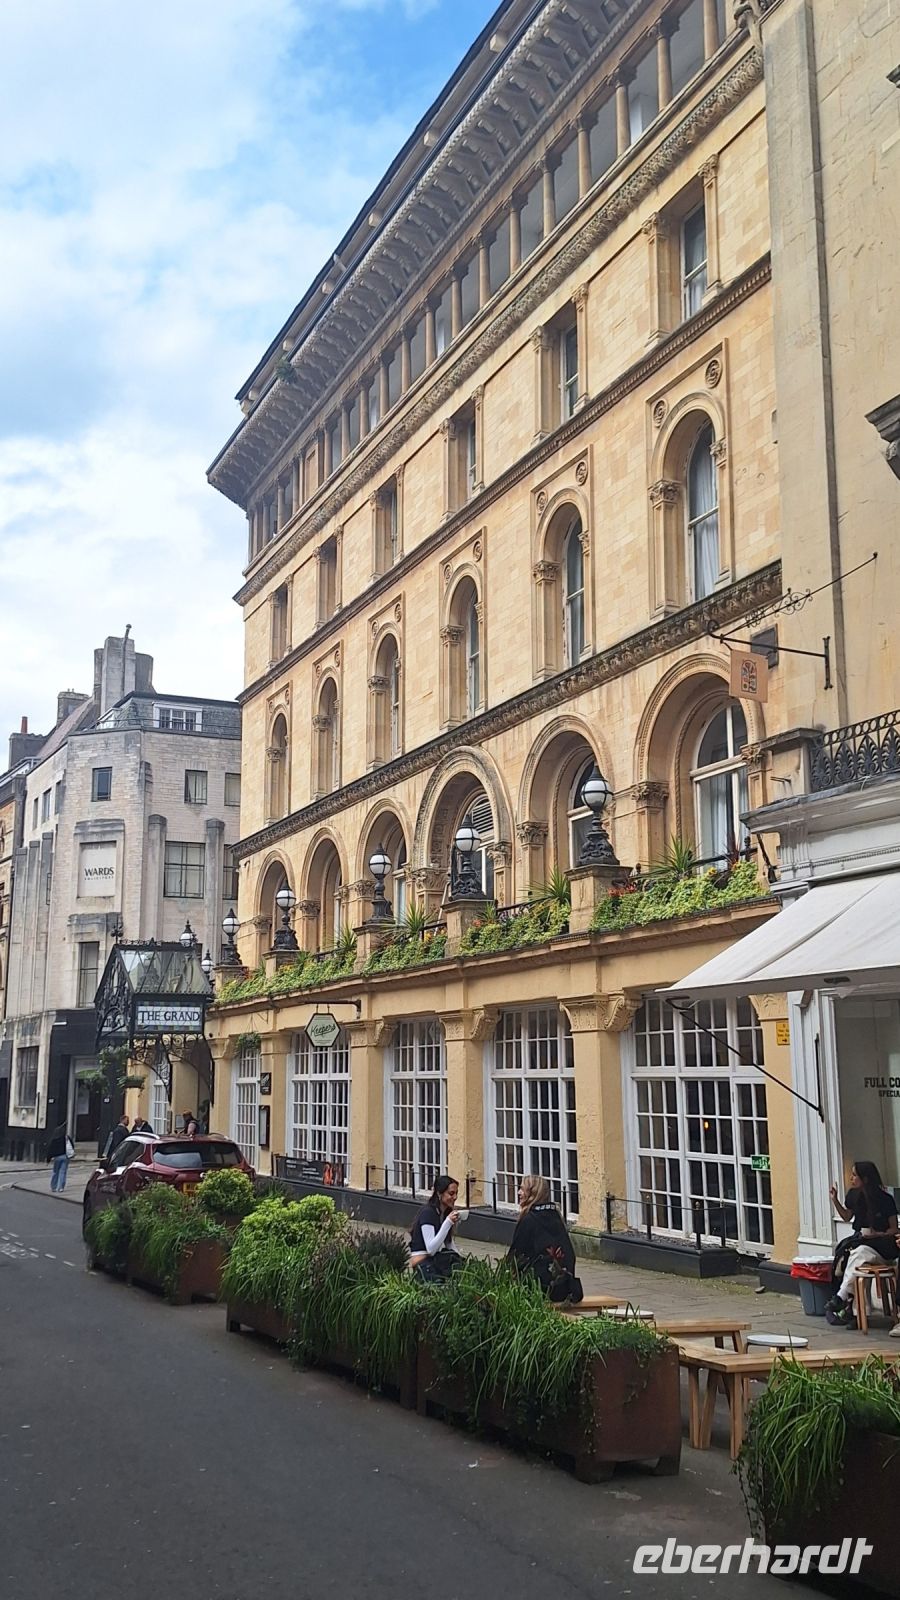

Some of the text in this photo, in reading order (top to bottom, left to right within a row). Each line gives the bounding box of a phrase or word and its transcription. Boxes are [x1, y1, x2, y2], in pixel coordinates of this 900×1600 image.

[84, 866, 115, 876] WARDS
[138, 1010, 160, 1024] THE
[163, 1010, 201, 1021] GRAND
[864, 1077, 887, 1088] FULL
